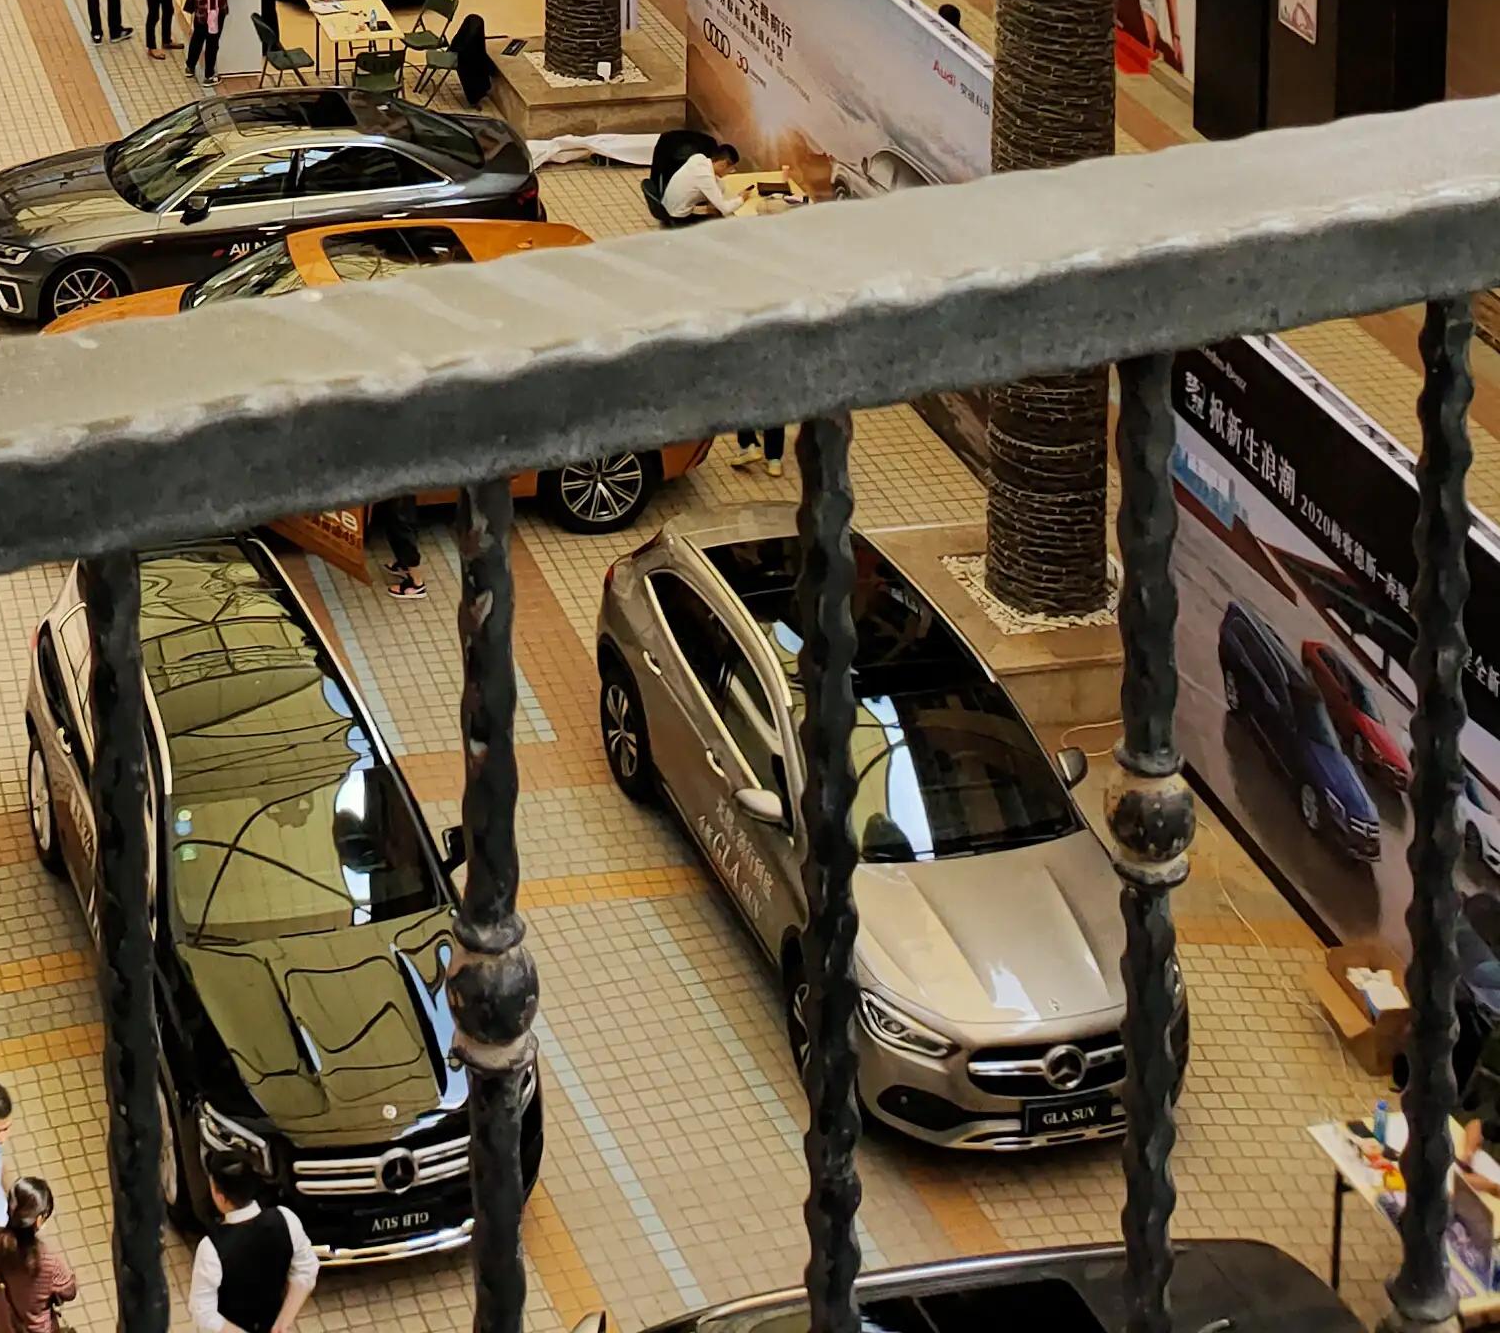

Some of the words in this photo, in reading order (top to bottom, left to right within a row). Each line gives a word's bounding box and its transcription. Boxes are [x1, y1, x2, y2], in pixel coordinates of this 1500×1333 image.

[932, 60, 956, 87] Audi
[1042, 1112, 1069, 1125] GLA
[1071, 1106, 1097, 1121] SUV
[371, 1215, 399, 1233] SUV
